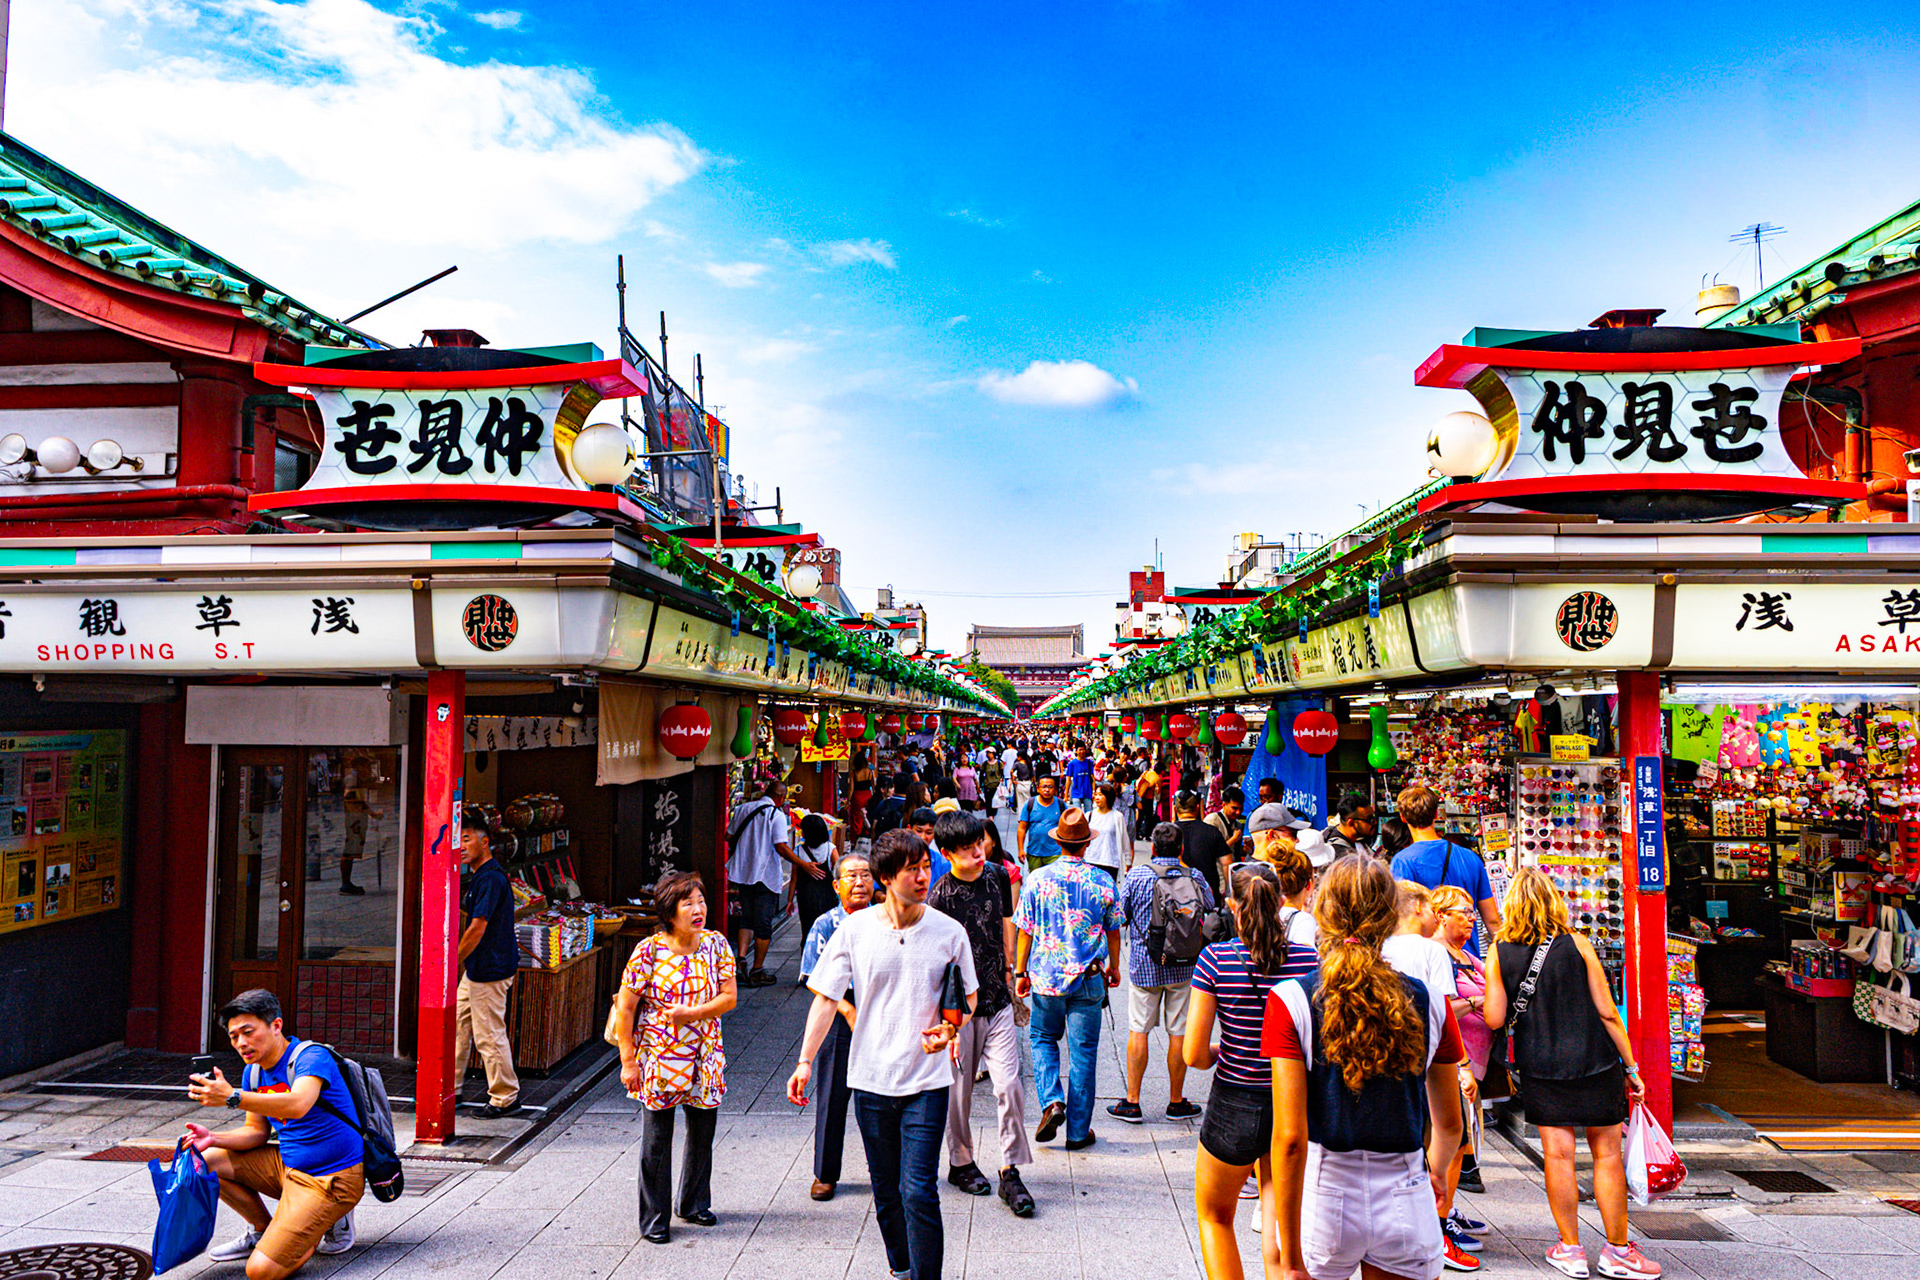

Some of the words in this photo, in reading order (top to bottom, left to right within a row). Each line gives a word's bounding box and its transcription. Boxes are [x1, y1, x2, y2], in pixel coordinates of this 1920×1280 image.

[1532, 380, 1768, 464] 仲見世
[1736, 589, 1920, 634] 浅草
[37, 643, 175, 661] SHOPPING
[215, 642, 256, 660] S.T
[1836, 634, 1920, 653] ASAK
[803, 746, 849, 760] サービス
[1643, 786, 1656, 858] 浅草一丁目
[1642, 867, 1660, 882] 18
